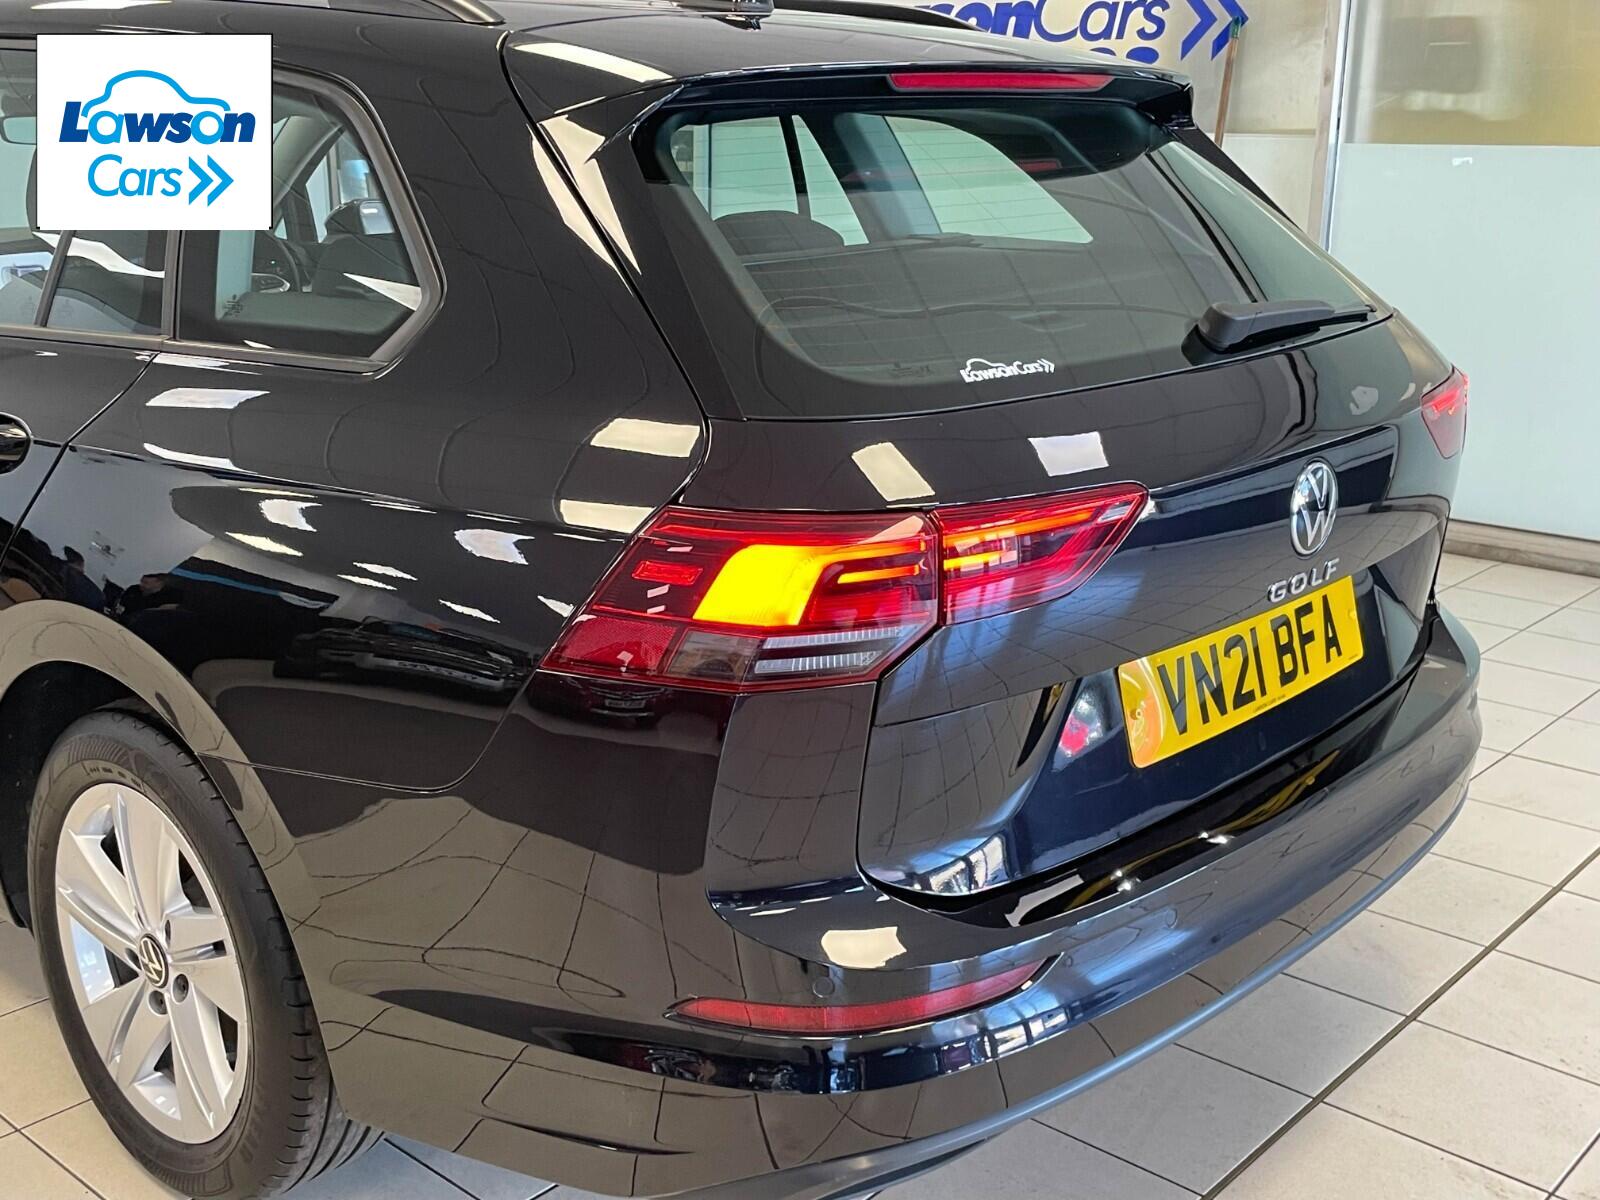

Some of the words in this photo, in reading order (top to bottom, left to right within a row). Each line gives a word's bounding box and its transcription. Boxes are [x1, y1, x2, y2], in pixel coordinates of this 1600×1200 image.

[1268, 558, 1340, 603] GOLF
[1157, 627, 1268, 736] VN21
[1270, 594, 1343, 688] BFA
